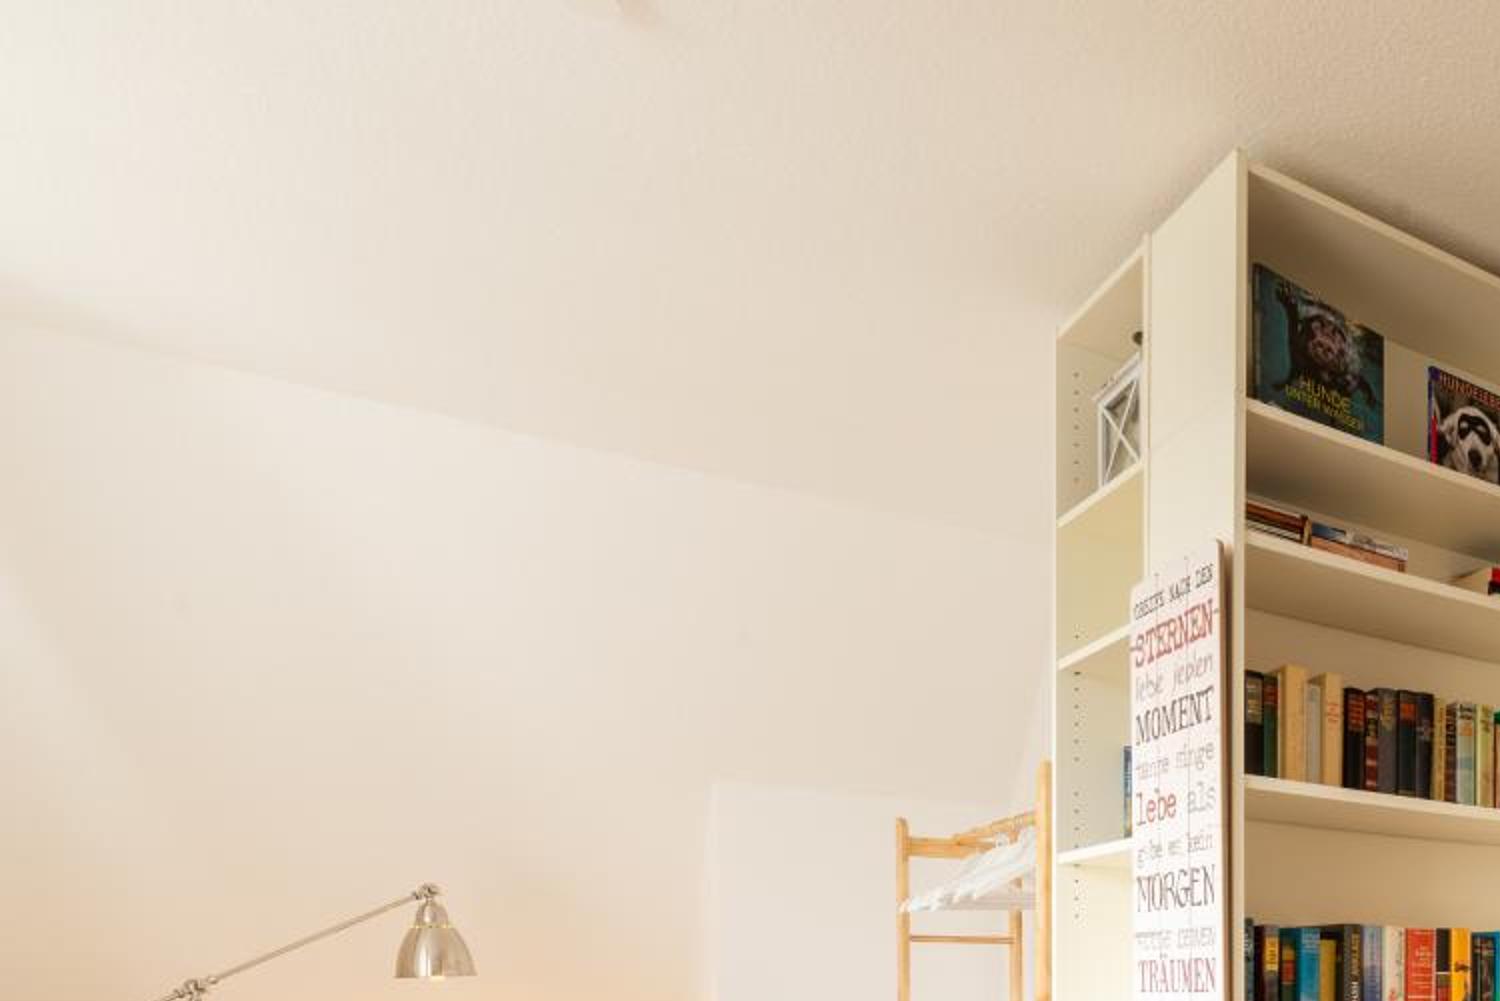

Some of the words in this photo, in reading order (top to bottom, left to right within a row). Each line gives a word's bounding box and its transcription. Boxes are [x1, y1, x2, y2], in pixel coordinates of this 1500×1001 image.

[1195, 563, 1214, 589] DEN
[1135, 597, 1214, 668] STERNEN
[1136, 685, 1215, 746] MOMENT
[1136, 787, 1177, 827] lebe
[1136, 863, 1216, 913] MORGEN
[1138, 952, 1217, 993] TRÄUMEN
